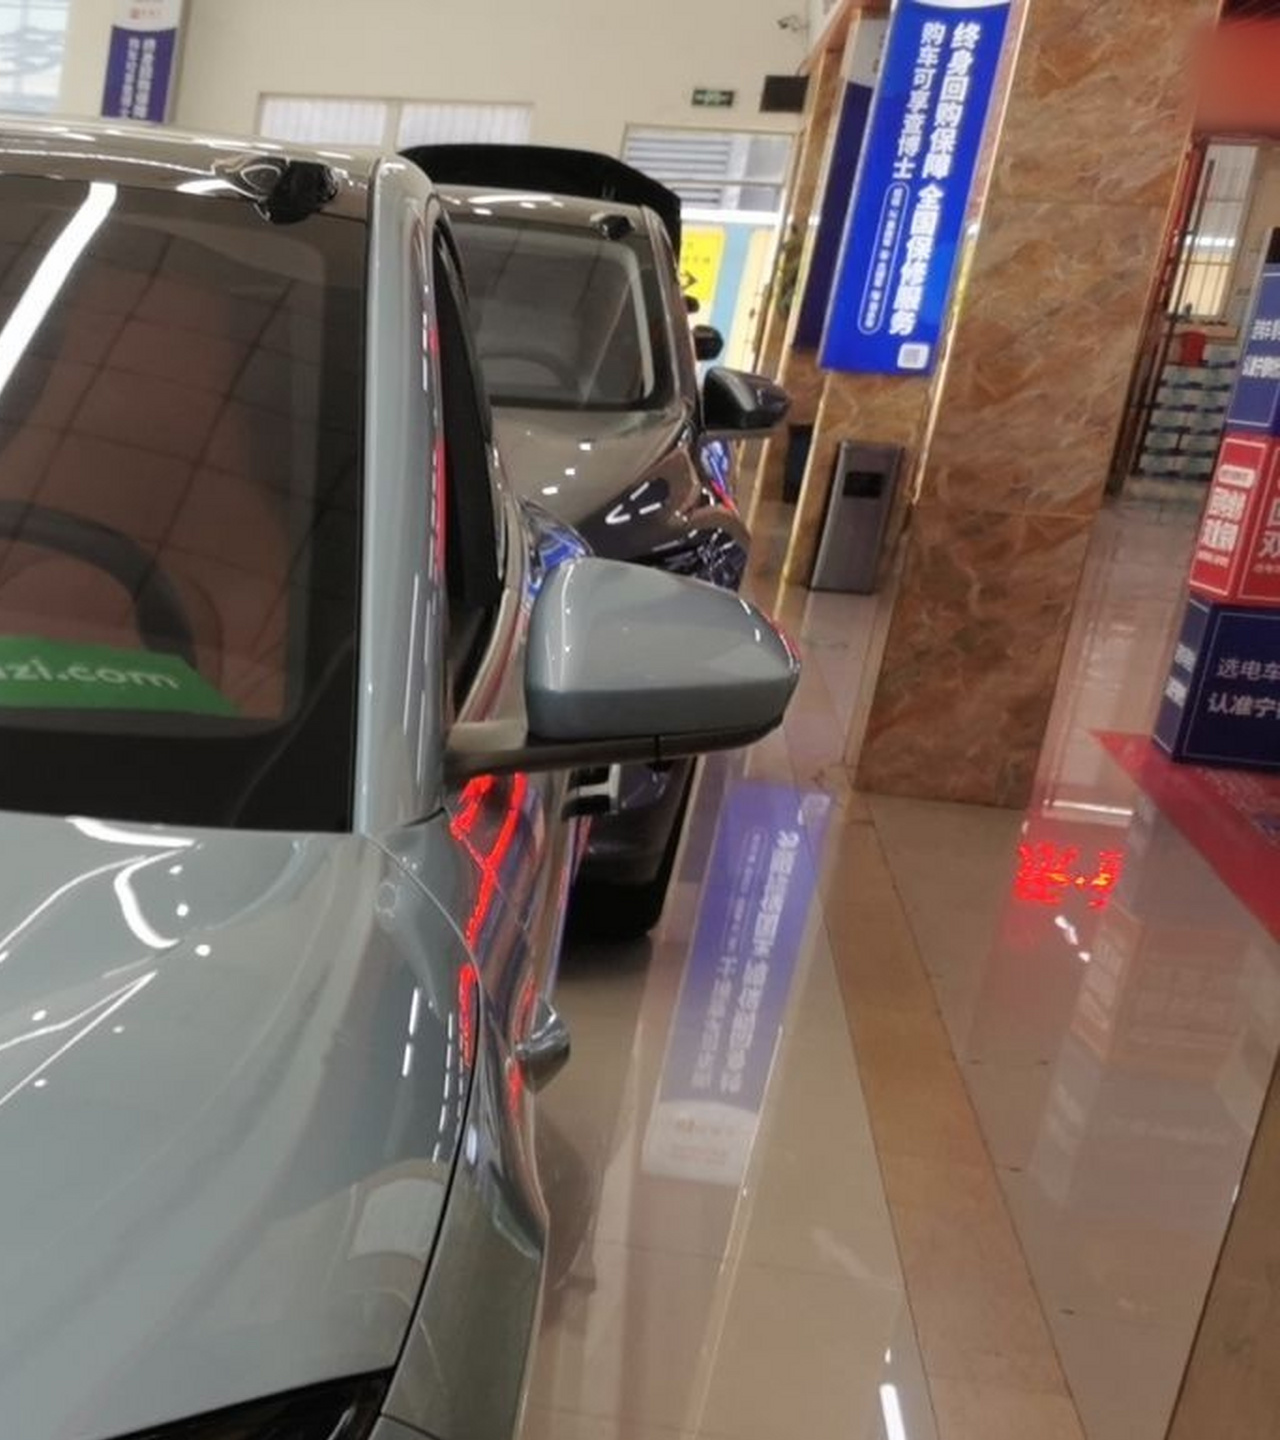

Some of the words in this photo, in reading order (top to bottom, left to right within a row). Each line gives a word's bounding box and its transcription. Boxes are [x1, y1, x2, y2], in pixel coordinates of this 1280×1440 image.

[892, 21, 946, 179] 购车可享查博士
[922, 21, 981, 180] 终身回购保障
[889, 184, 944, 336] 全国保修服务
[1217, 658, 1280, 681] 选电车
